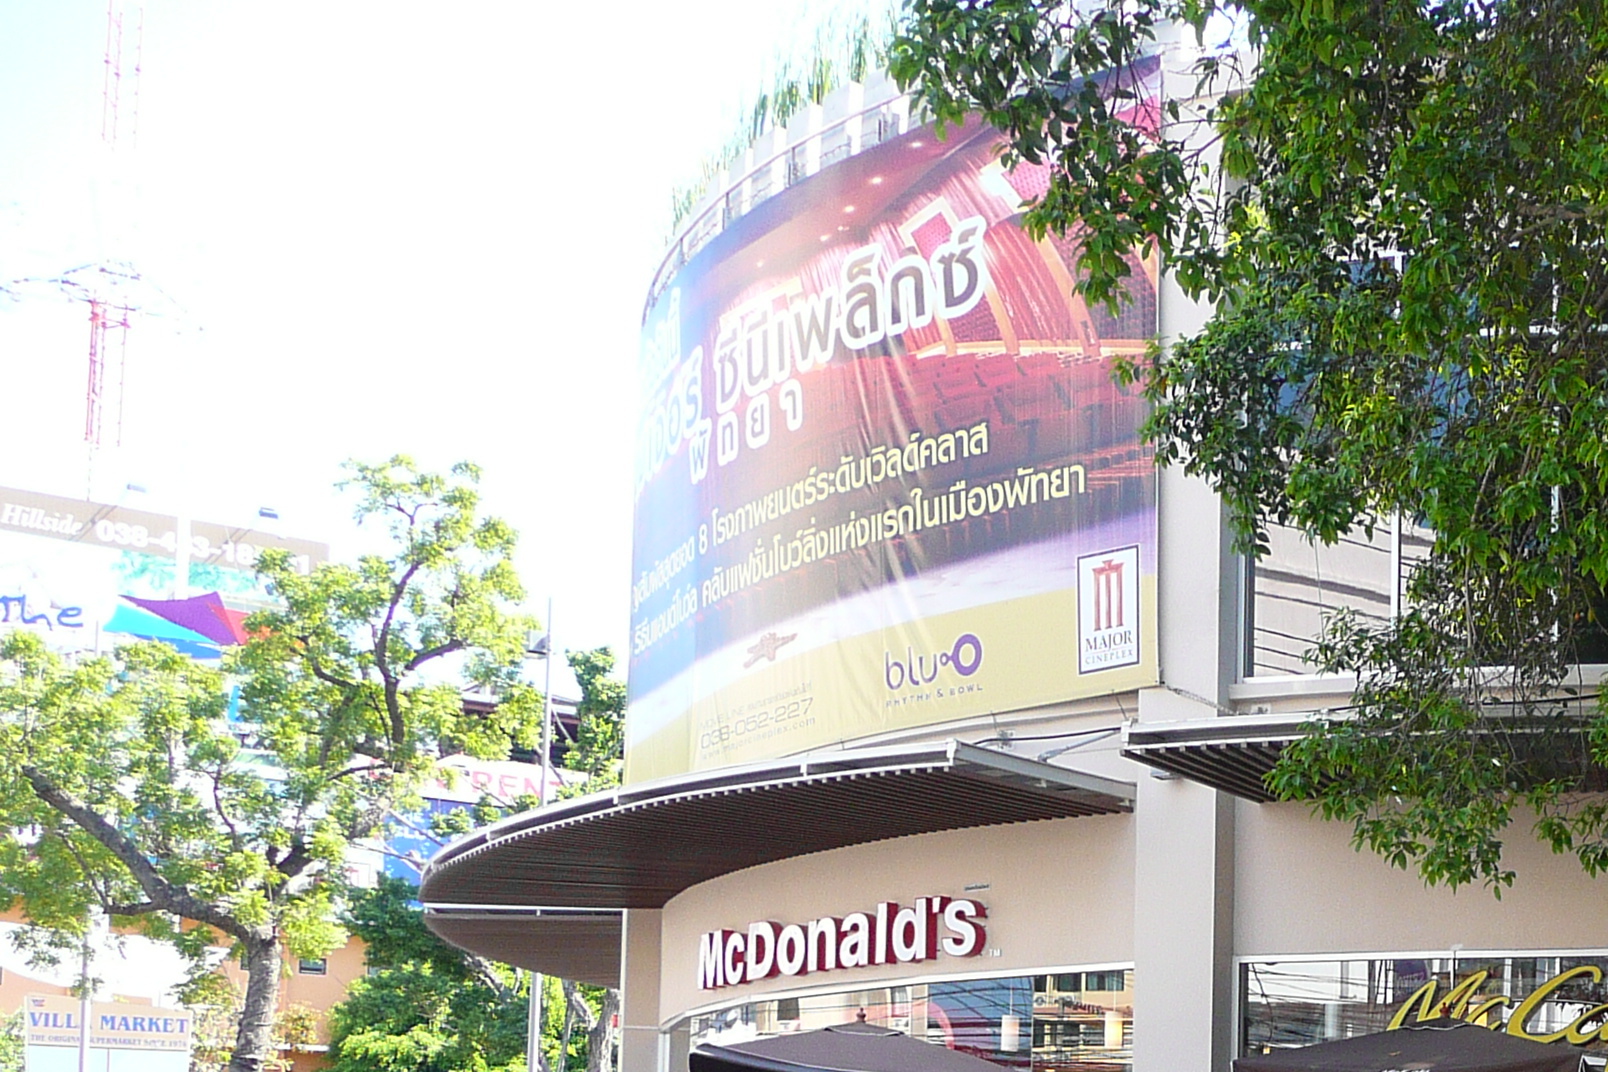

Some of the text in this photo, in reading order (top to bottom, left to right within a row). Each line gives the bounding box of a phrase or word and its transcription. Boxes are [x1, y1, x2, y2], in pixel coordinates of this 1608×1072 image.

[689, 379, 802, 486] พัทยา
[698, 524, 709, 555] 8
[712, 422, 989, 547] โรงภาพยนตร์ระดับเวิลด์คลาส
[1, 503, 84, 535] Hillside
[1085, 630, 1133, 652] MAJOR
[1085, 650, 1133, 665] CINEPLEX
[937, 688, 944, 699] &
[950, 684, 984, 697] BOWL
[701, 697, 814, 750] 038-052-227
[698, 895, 987, 989] McDonald's
[30, 1011, 189, 1034] VILL MARKET
